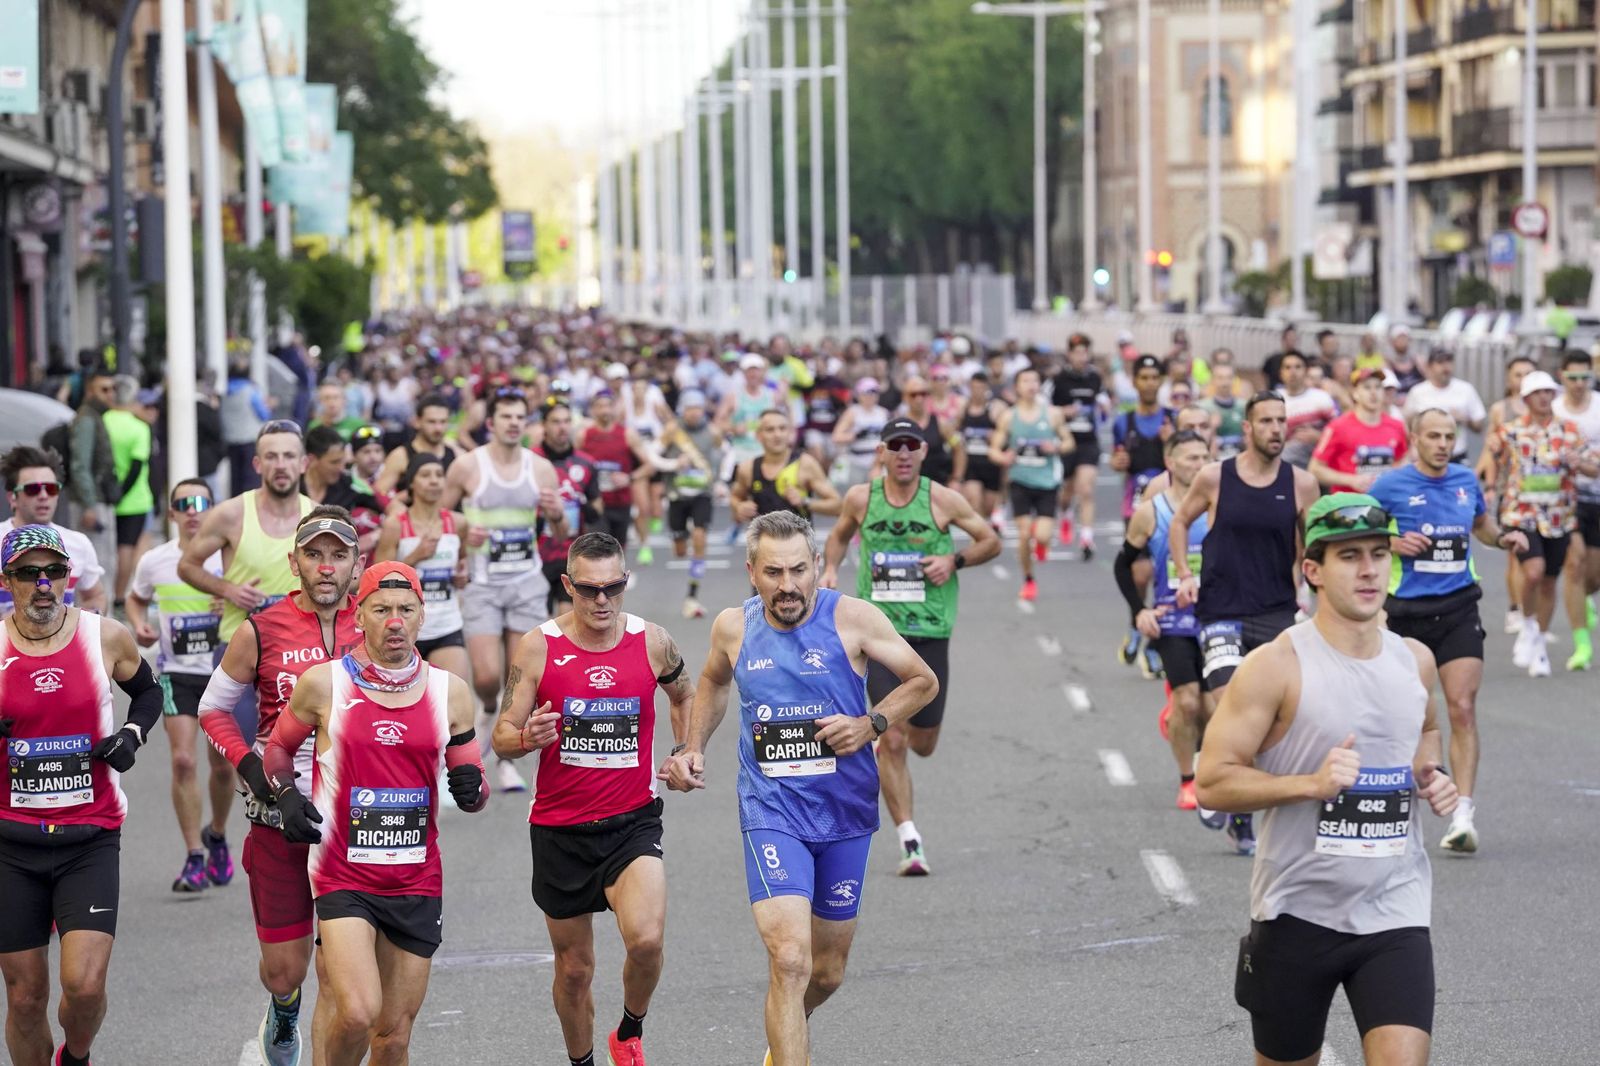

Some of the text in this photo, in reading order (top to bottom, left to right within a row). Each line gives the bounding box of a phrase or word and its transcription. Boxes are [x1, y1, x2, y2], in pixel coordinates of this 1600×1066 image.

[282, 646, 324, 665] PICO
[747, 658, 774, 671] LAVA
[590, 701, 632, 712] ZURICH
[777, 704, 822, 717] ZURICH
[591, 723, 614, 733] 4600
[780, 727, 804, 739] 3844
[35, 740, 82, 752] ZURICH
[561, 736, 639, 752] JOSEYROSA
[765, 741, 822, 760] CARPIN
[37, 761, 63, 773] 4495
[11, 773, 92, 792] ALEJANDRO
[1358, 773, 1406, 786] ZURICH
[380, 793, 424, 803] ZURICH
[1357, 799, 1387, 813] 4242
[380, 815, 406, 826] 3848
[1361, 820, 1409, 840] QUIGLEY
[357, 829, 421, 846] RICHARD
